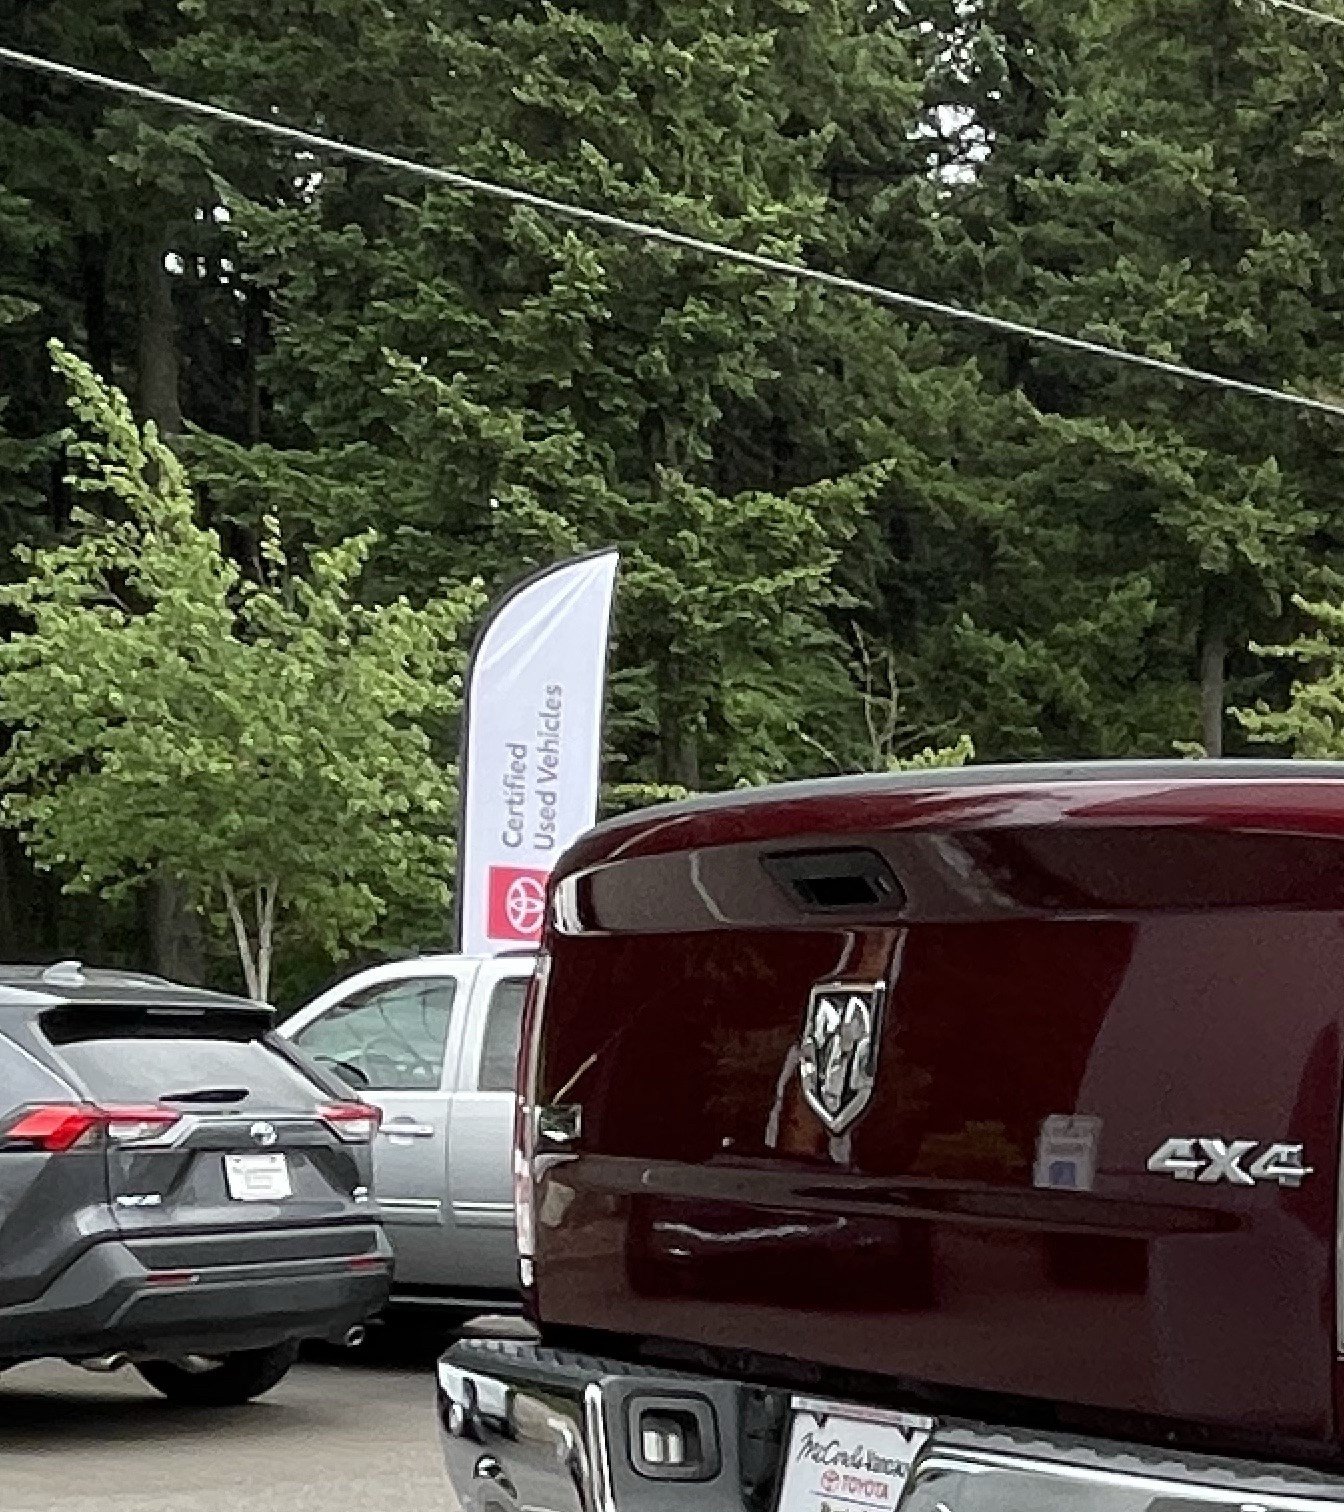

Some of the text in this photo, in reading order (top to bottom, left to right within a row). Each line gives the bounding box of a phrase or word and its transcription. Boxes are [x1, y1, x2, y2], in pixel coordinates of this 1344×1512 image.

[501, 742, 528, 848] Certified
[534, 684, 562, 850] Used Vehicles
[842, 1474, 890, 1500] TOYOTA
